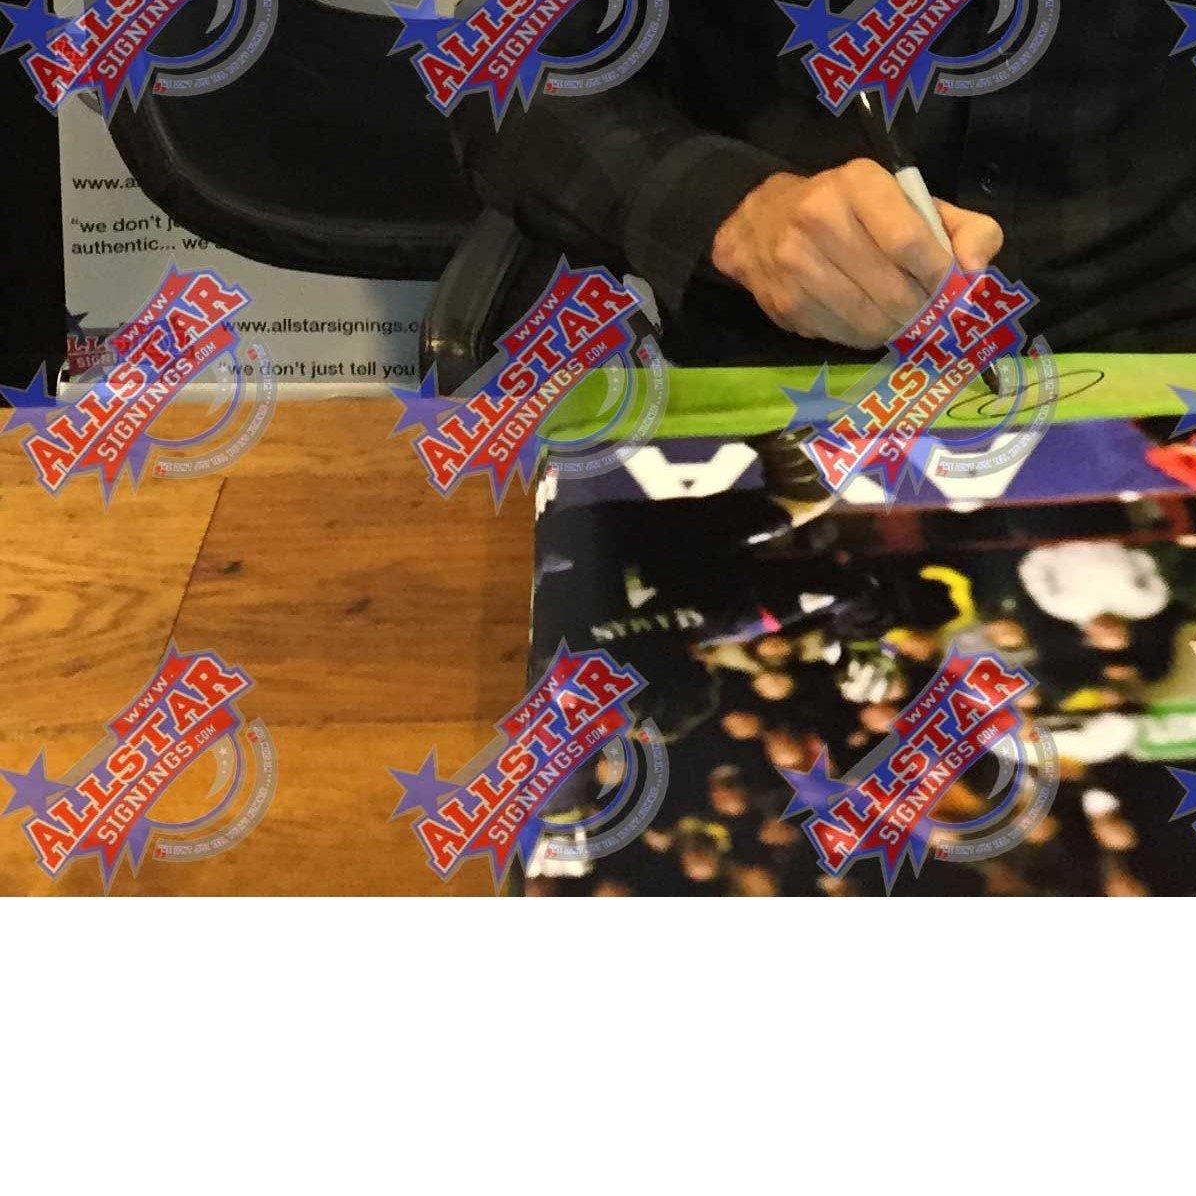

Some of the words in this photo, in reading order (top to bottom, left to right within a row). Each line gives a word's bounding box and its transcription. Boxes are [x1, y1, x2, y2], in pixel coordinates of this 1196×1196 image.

[113, 216, 161, 232] don't
[71, 238, 176, 255] authentic...
[221, 318, 419, 336] www.allstarsignings.c
[260, 361, 306, 376] don't
[310, 362, 344, 378] just
[351, 362, 376, 376] tell
[382, 365, 416, 378] you
